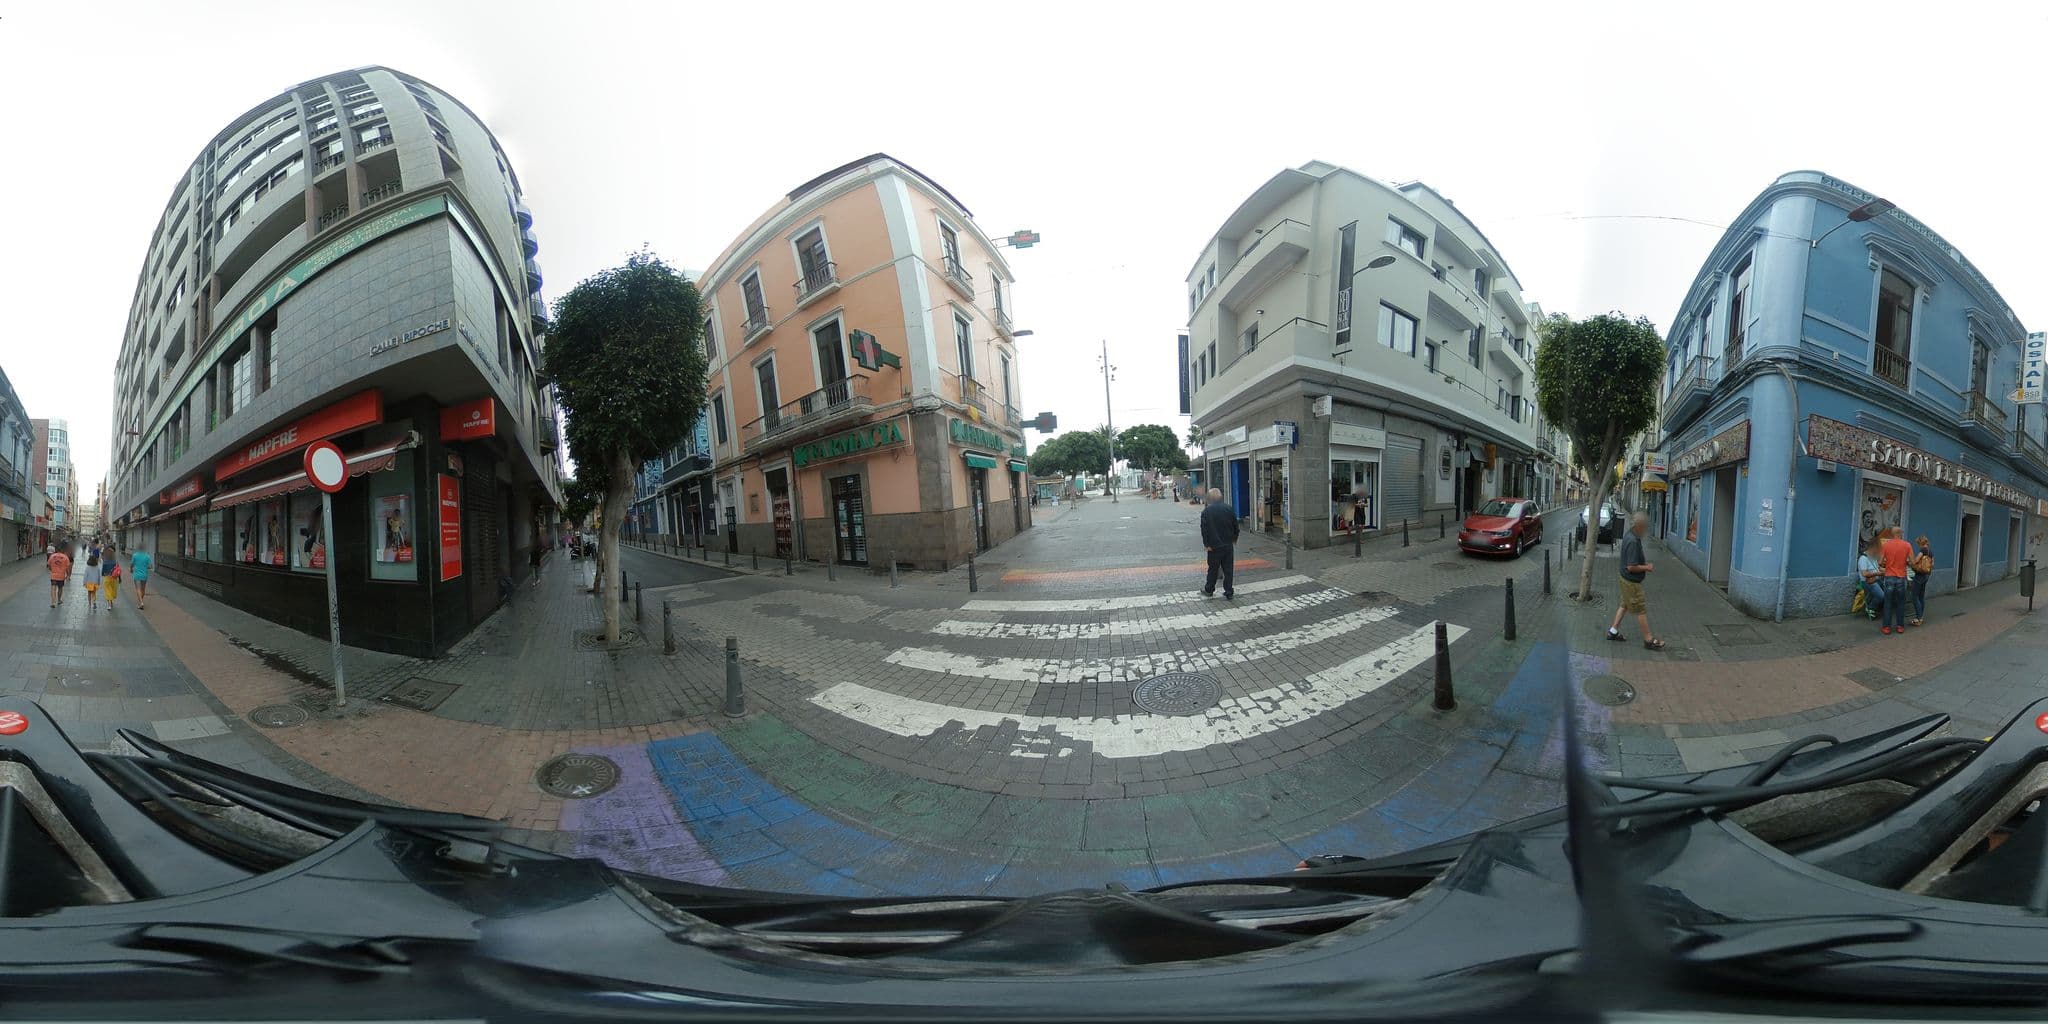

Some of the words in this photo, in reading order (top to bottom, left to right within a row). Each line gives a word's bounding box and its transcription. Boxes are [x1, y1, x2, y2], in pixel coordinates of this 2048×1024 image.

[370, 337, 398, 354] CALLE
[404, 319, 449, 341] RIPOCHE
[2026, 332, 2044, 388] HOSTAL
[463, 418, 490, 429] MAPFRE
[811, 419, 905, 462] FARMACIA
[249, 427, 298, 461] MAPFRE
[1870, 440, 1930, 478] SALON
